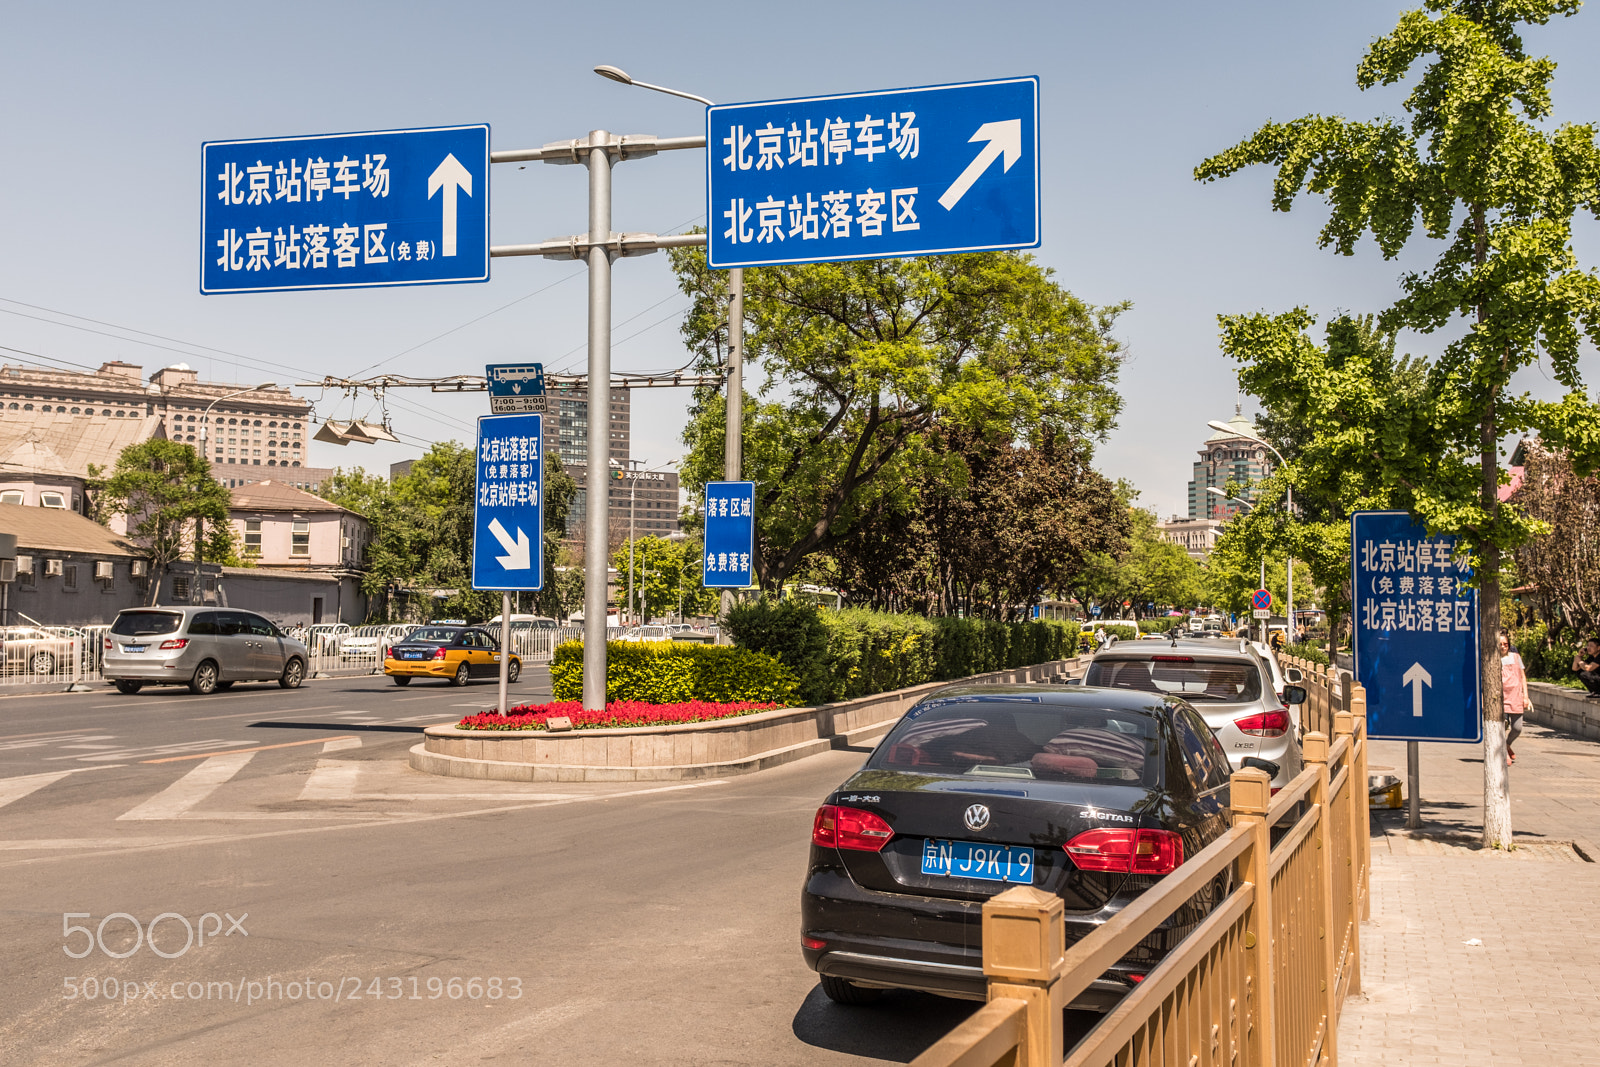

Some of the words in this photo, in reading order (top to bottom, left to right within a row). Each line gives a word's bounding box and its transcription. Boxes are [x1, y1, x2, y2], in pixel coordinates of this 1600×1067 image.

[723, 112, 919, 171] 北京站停车场
[218, 154, 390, 206] 北京站停车场
[724, 187, 920, 244] 北京站落客区
[481, 435, 538, 462] 北京站落客区
[480, 481, 537, 507] 北京站停车场
[708, 497, 751, 517] 落客区域
[707, 552, 750, 572] 免费落客
[1363, 598, 1471, 632] 北京站落客区
[1080, 811, 1134, 823] SAGITAR
